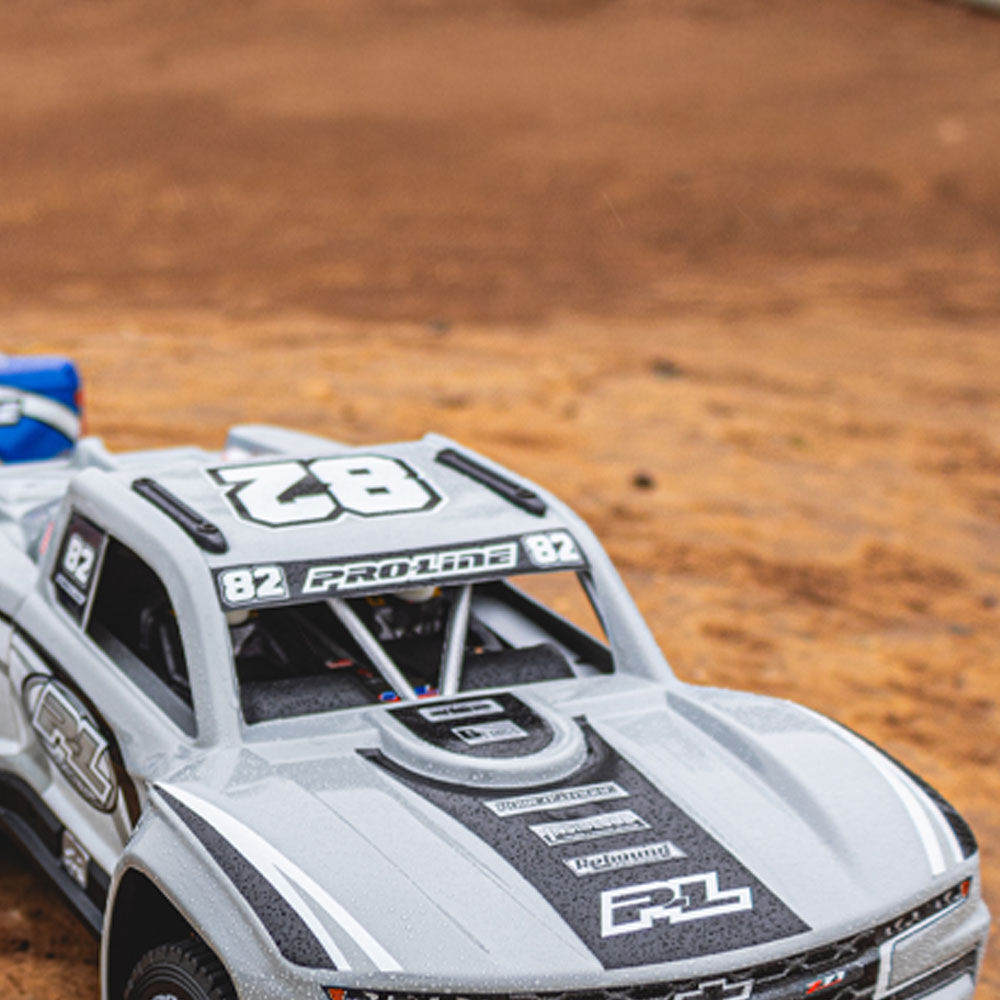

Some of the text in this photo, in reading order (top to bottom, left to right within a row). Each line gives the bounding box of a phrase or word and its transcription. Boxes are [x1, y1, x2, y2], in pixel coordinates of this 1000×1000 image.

[64, 533, 95, 588] 82
[220, 565, 288, 605] 82
[521, 531, 583, 567] 82
